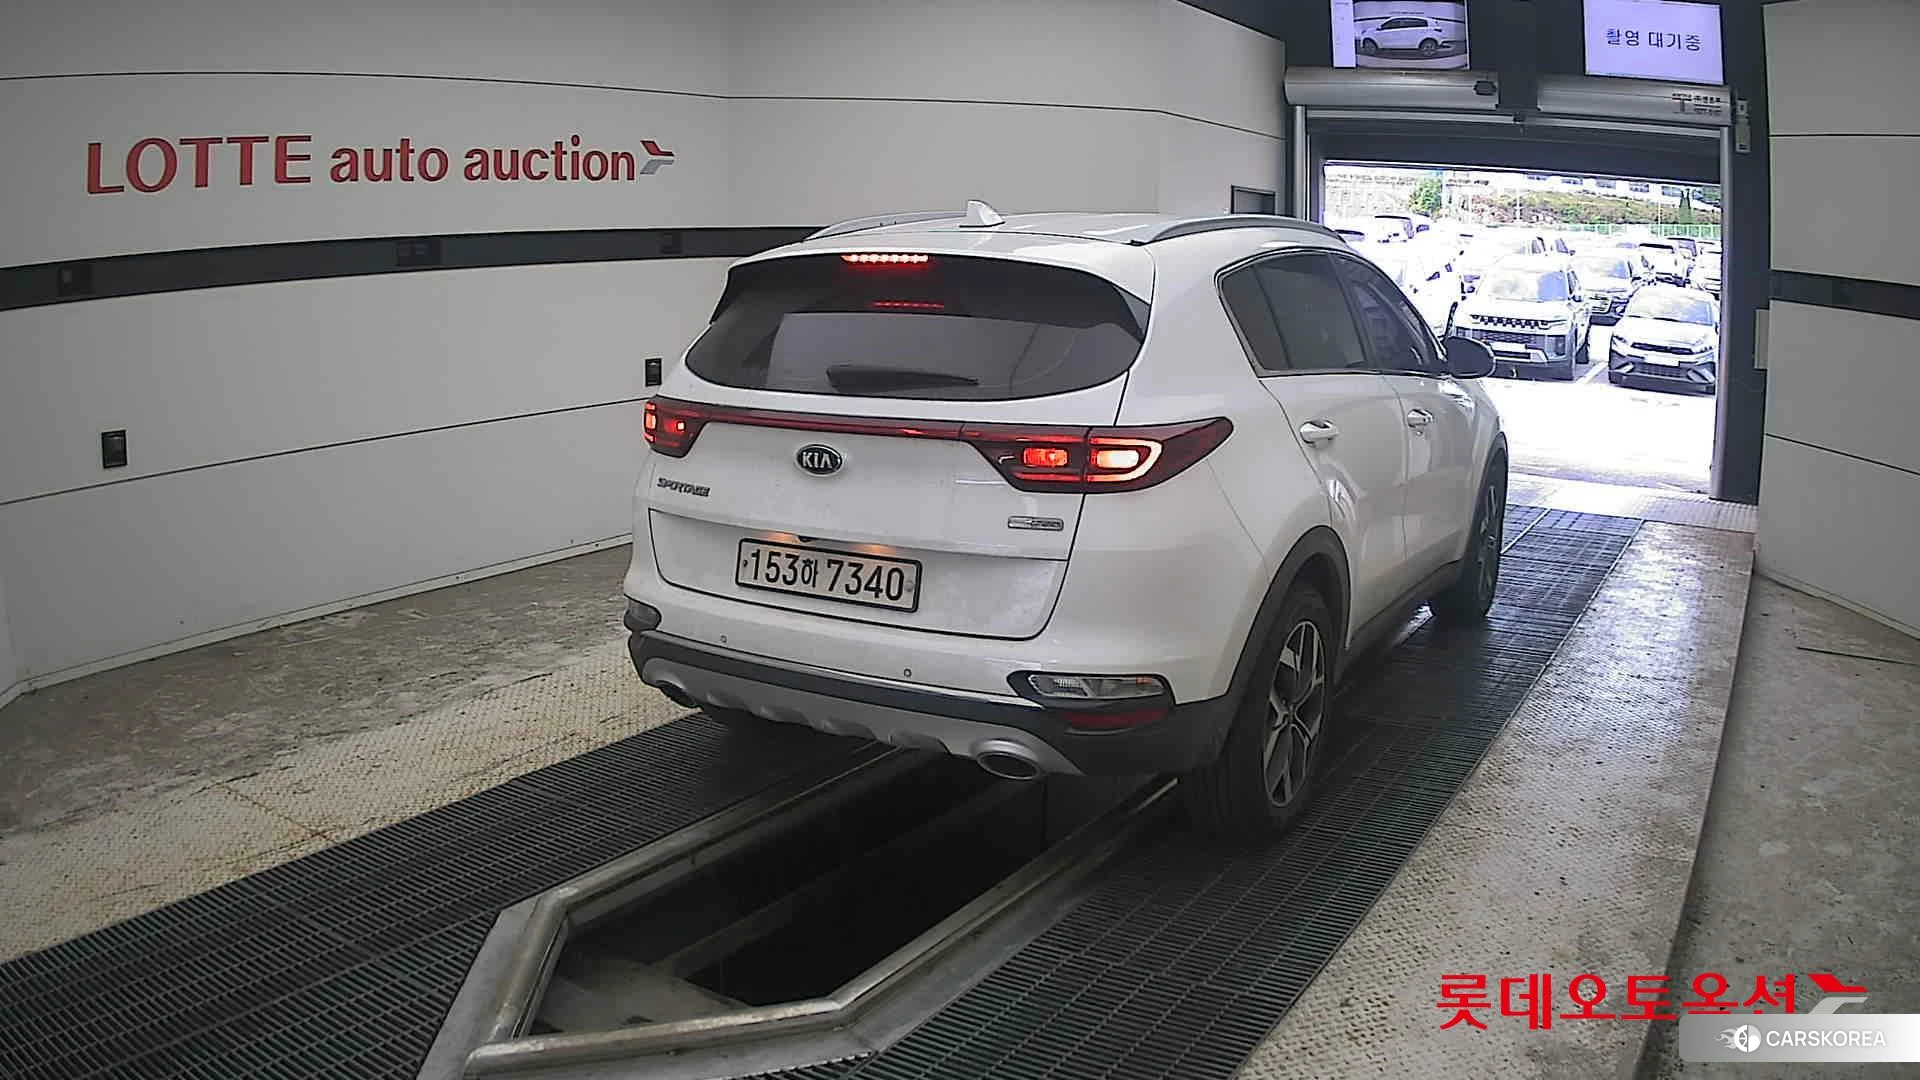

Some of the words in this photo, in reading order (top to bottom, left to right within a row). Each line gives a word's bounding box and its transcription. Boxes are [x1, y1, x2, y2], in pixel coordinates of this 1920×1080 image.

[1648, 31, 1701, 52] 대기중
[87, 135, 312, 194] LOTTE
[330, 138, 449, 183] auto
[463, 134, 636, 182] auction
[802, 451, 833, 469] KIA
